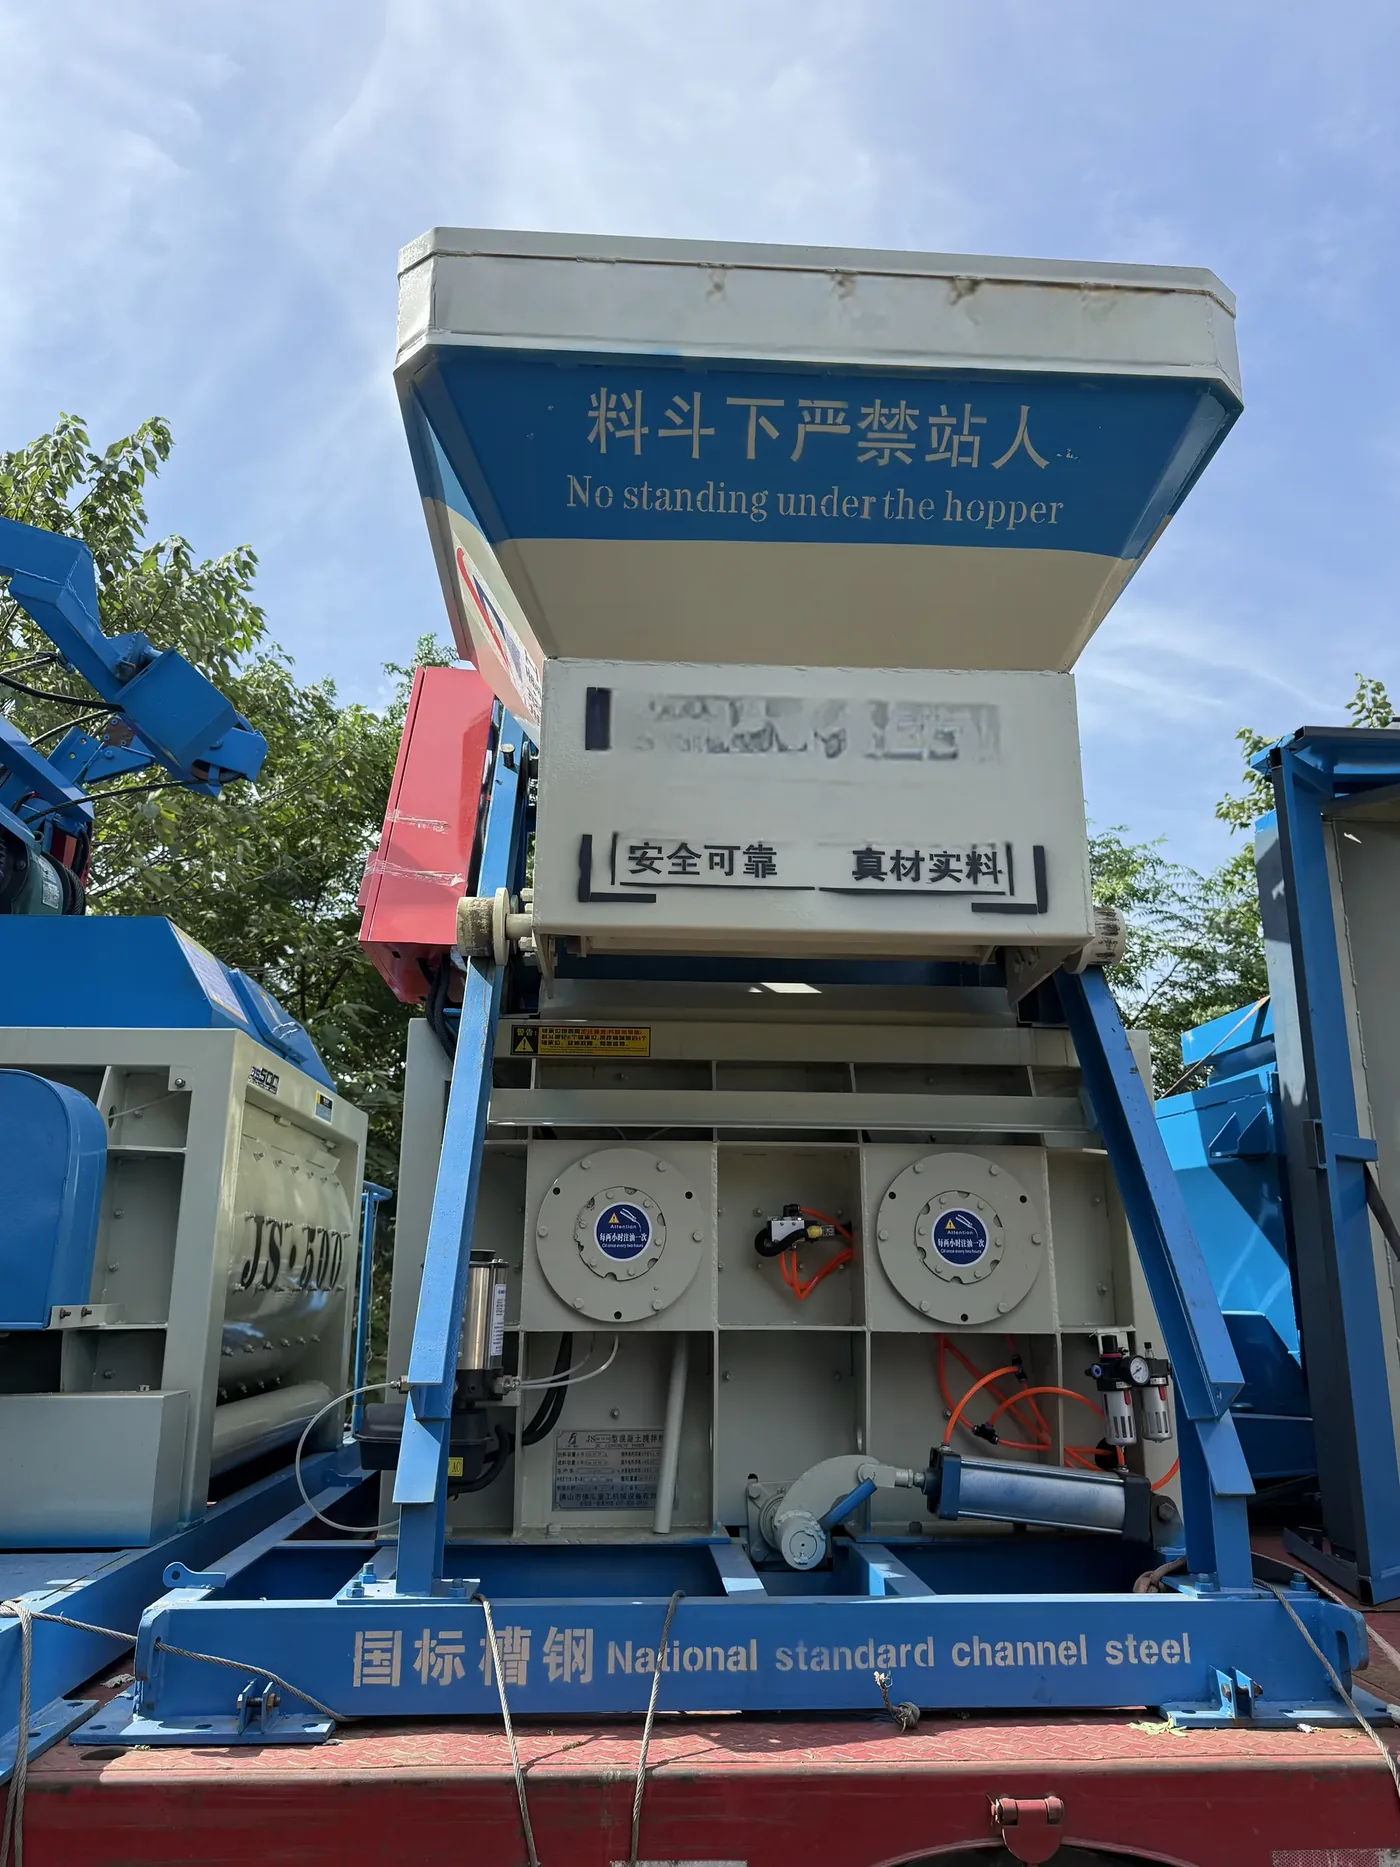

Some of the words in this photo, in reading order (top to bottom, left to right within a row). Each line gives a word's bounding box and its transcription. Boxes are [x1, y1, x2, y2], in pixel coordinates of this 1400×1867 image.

[587, 387, 1050, 470] 料斗下严禁站人
[566, 474, 614, 509] No
[623, 481, 769, 523] standing
[777, 485, 876, 520] under
[883, 488, 935, 520] the
[943, 490, 1064, 531] hopper
[628, 842, 778, 879] 安全可靠
[852, 847, 1003, 885] 真材实料
[353, 1625, 595, 1688] 国标槽钢
[607, 1638, 758, 1675] National
[775, 1636, 934, 1671] standard
[951, 1634, 1088, 1667] channel
[1105, 1632, 1191, 1665] steel
